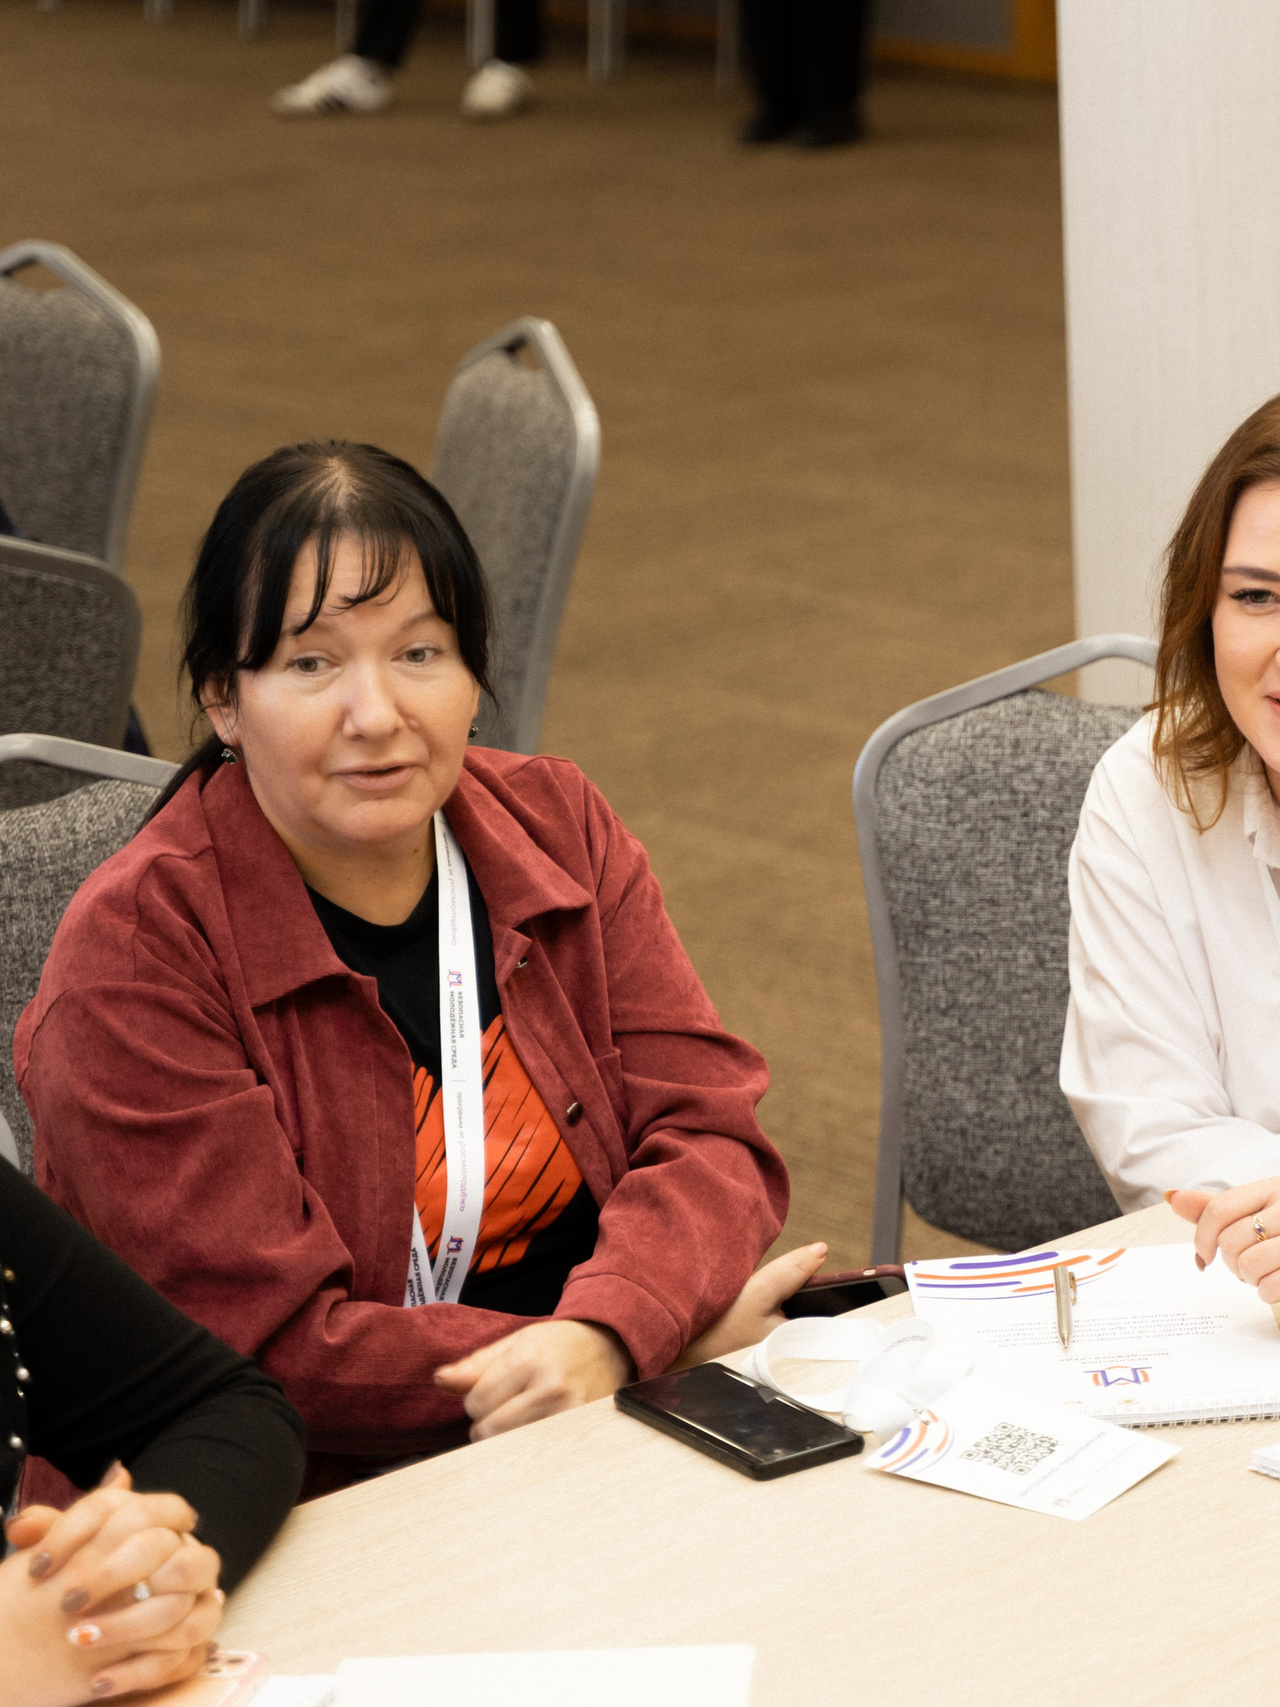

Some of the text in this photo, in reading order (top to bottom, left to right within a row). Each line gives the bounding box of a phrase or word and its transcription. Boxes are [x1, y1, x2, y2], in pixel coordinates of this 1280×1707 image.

[457, 991, 465, 1038] БЕЗОПАСНАЯ
[411, 1247, 420, 1271] СРЕДА
[407, 1279, 417, 1307] ПАСНАЯ
[439, 1257, 458, 1301] БЕЗОПАСНАЯ
